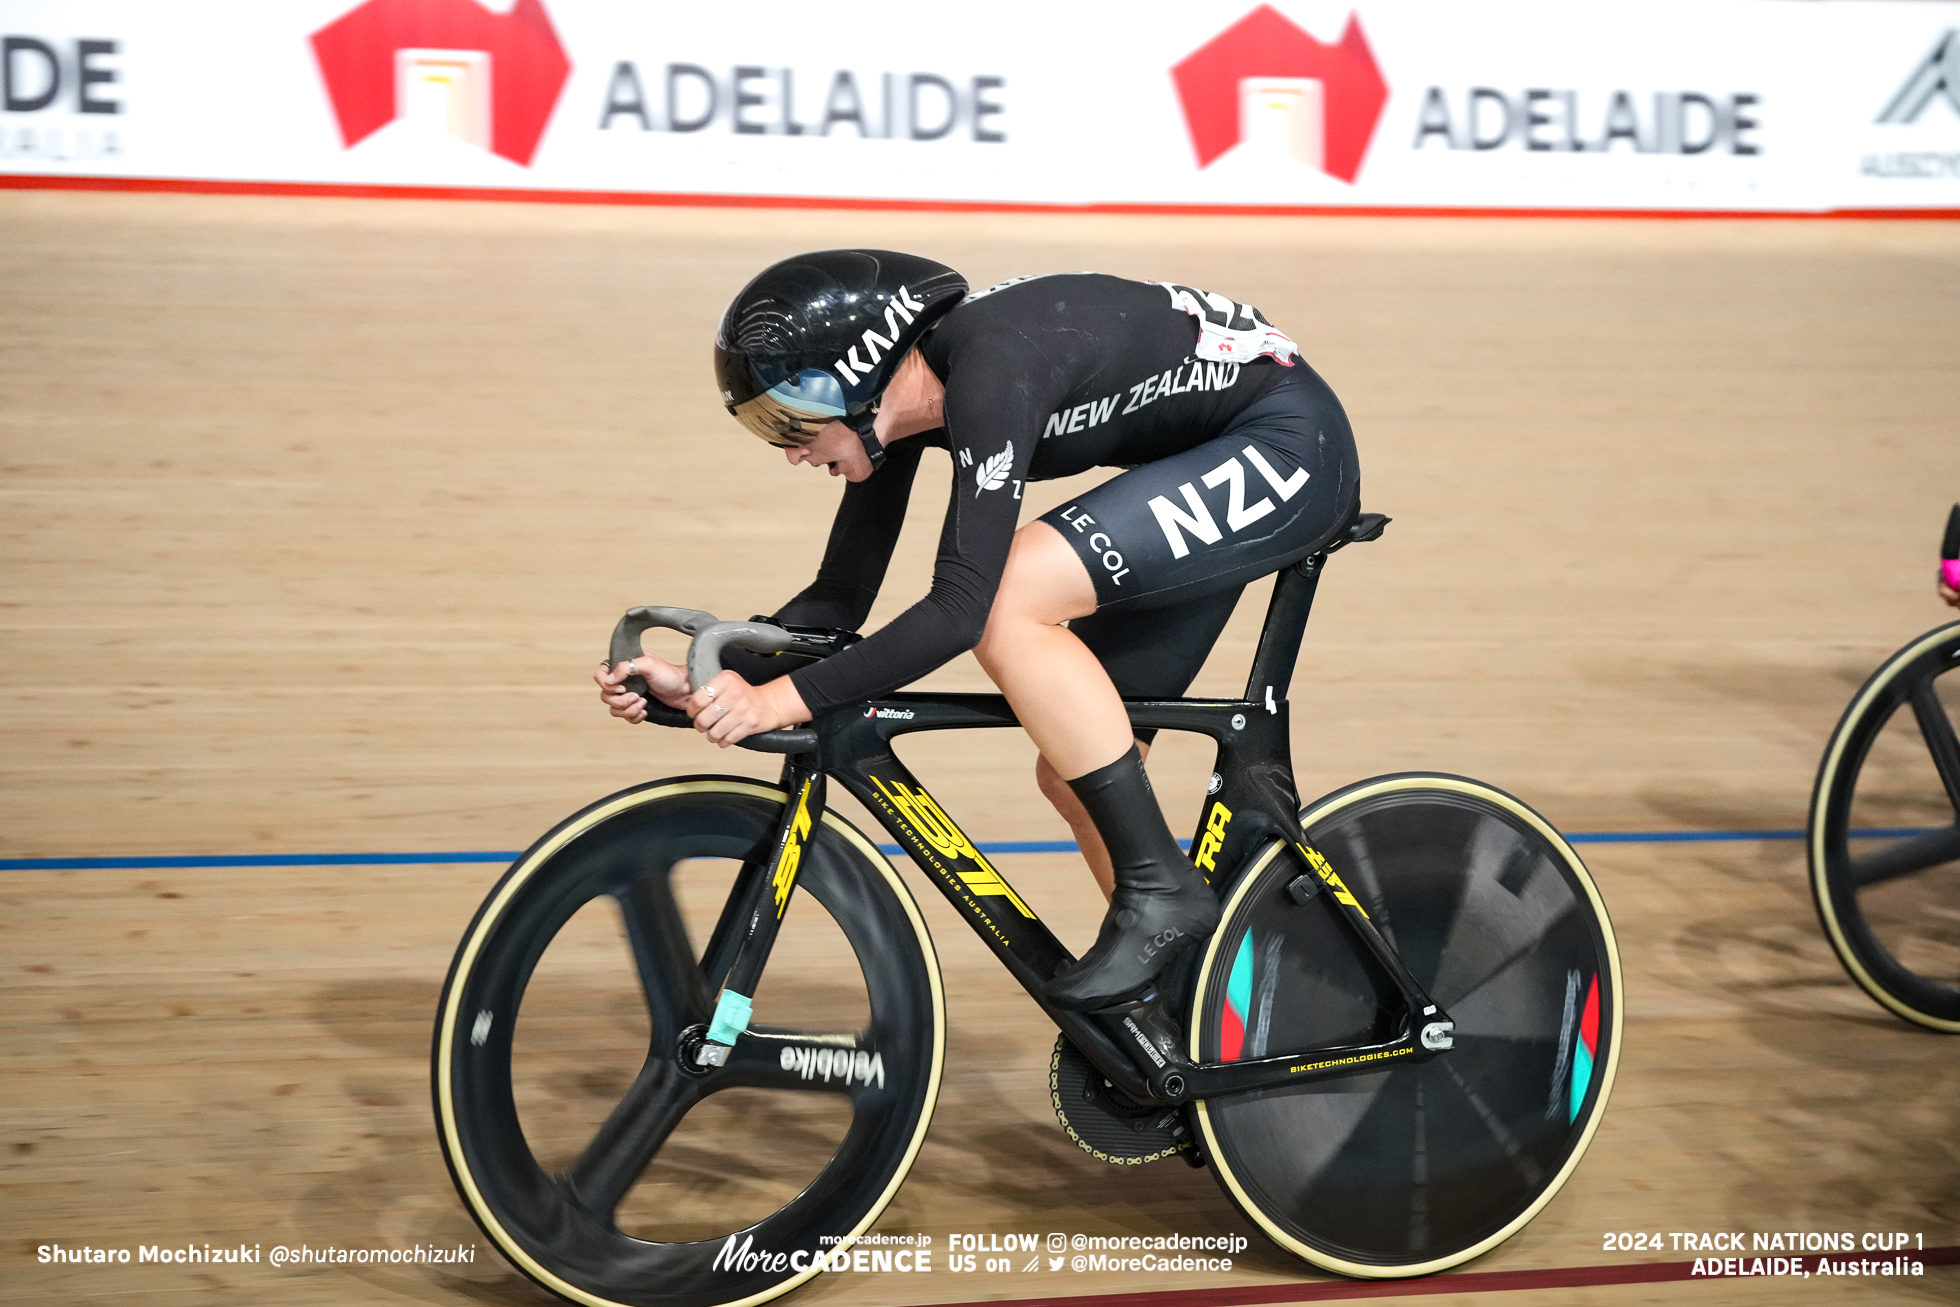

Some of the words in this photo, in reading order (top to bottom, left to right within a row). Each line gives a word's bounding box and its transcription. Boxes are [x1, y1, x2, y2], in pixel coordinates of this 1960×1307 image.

[596, 60, 1008, 144] ADELAIDE
[1412, 86, 1762, 156] ADELAIDE
[834, 285, 925, 387] KASK
[1043, 393, 1121, 438] NEW
[1122, 362, 1240, 415] ZEALAND
[959, 447, 973, 468] N
[1012, 480, 1021, 499] Z
[1147, 445, 1310, 559] NZL
[1060, 506, 1095, 533] LE
[1089, 533, 1130, 586] COL
[872, 791, 894, 816] BIKE
[896, 816, 962, 892] TECHNOLOGIES
[963, 893, 1010, 947] AUSTRALIA
[1137, 943, 1157, 966] LE
[1153, 926, 1185, 949] COL
[780, 1045, 886, 1091] Velobike
[1290, 1047, 1414, 1074] BIKETECHNOLOGIES.COM
